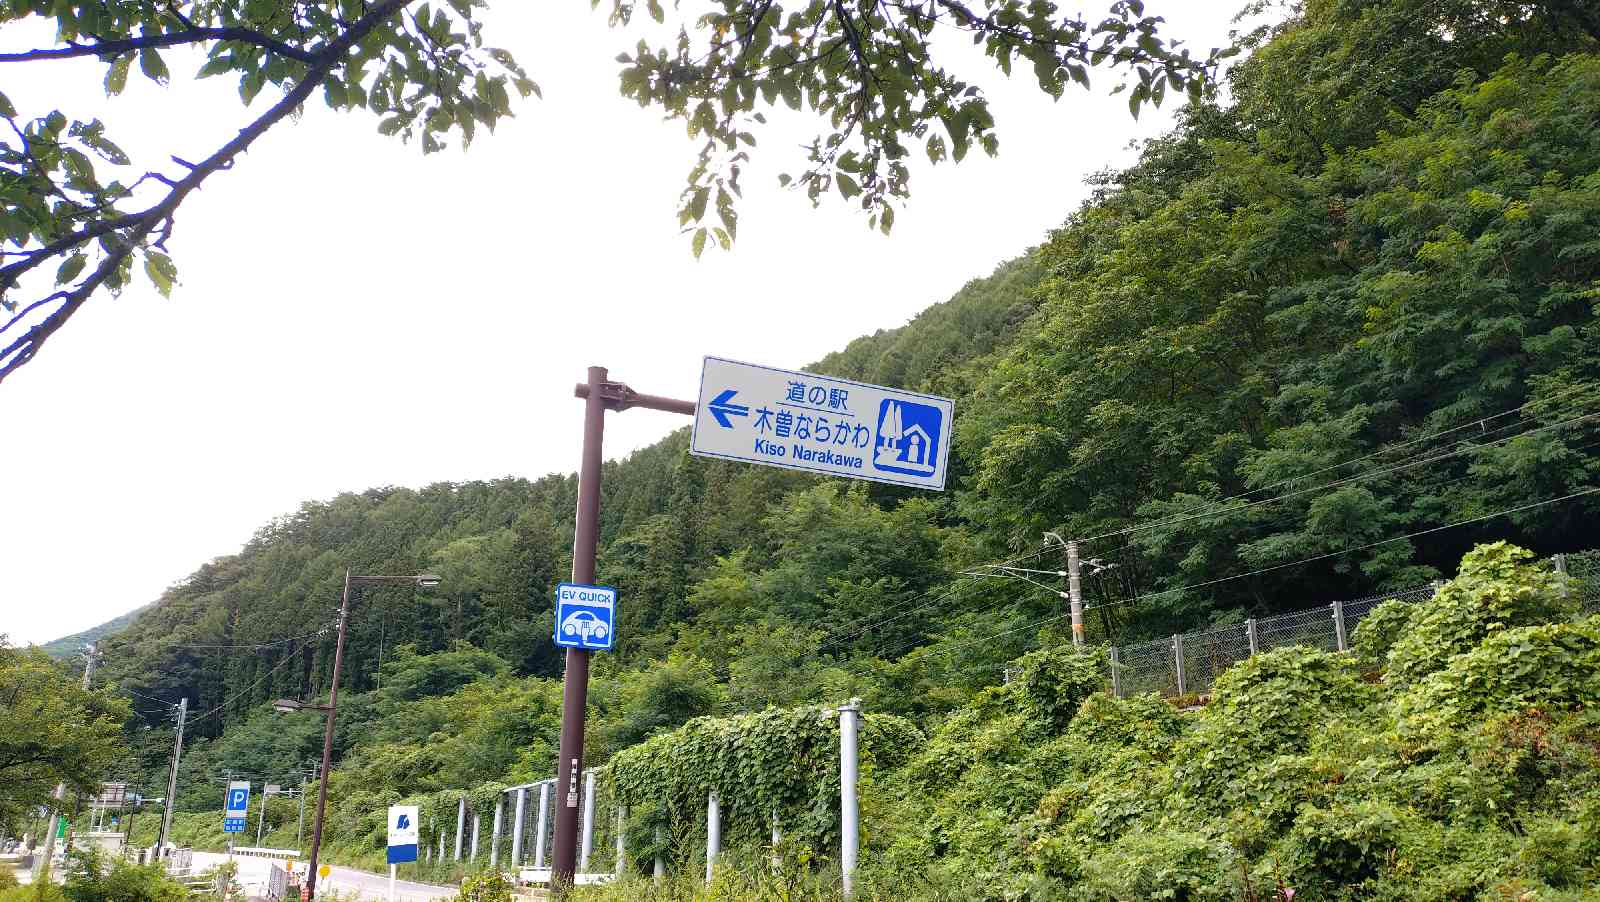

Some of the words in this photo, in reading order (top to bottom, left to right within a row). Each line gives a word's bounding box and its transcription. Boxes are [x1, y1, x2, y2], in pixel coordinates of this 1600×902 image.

[785, 380, 849, 410] 道の駅
[753, 406, 870, 449] 木曽ならかわ
[754, 439, 786, 457] Kiso
[792, 444, 863, 468] Narakawa
[562, 590, 575, 600] EV
[578, 591, 610, 603] QUICK
[233, 791, 244, 808] P
